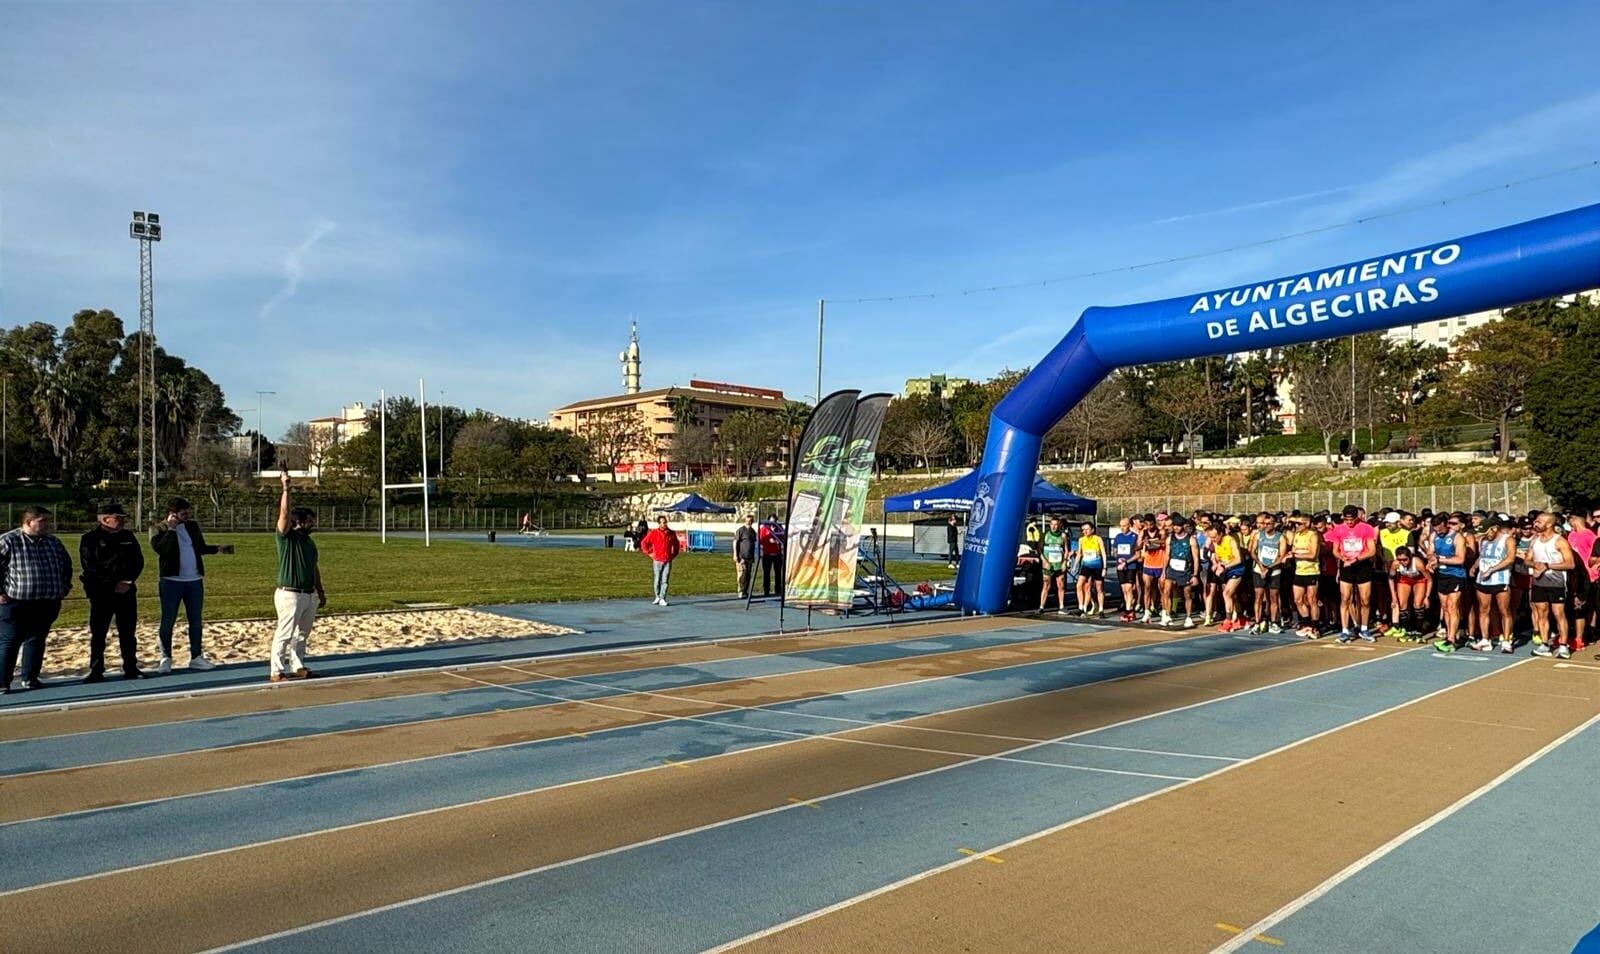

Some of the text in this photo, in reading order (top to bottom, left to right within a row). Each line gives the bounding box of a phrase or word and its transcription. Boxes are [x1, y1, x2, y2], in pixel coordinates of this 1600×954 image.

[1189, 244, 1461, 314] AYUNTAMIENTO
[1206, 277, 1439, 339] DE ALGECIRAS
[965, 543, 988, 554] ORTES
